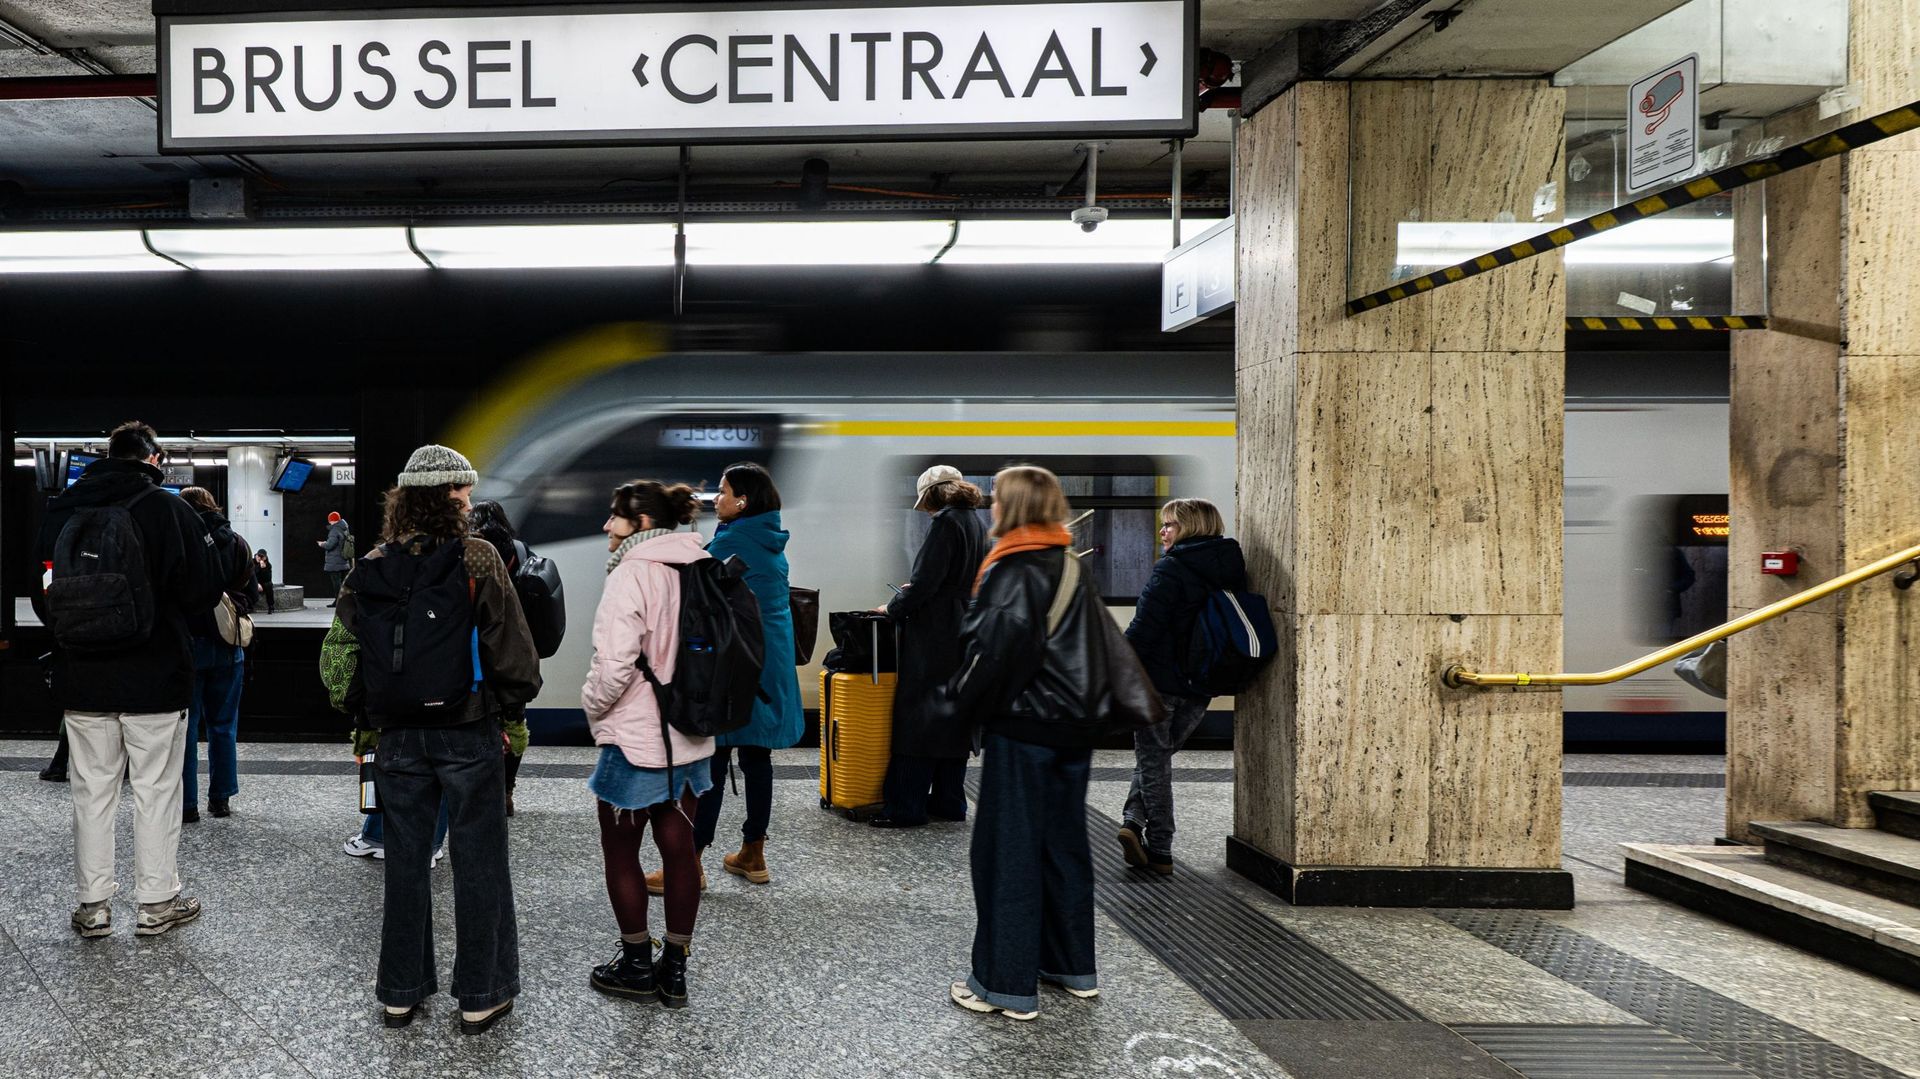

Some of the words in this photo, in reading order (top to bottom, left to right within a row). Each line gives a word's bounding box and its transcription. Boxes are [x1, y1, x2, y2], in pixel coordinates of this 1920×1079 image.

[193, 40, 557, 114] BRUSSEL
[661, 27, 1128, 104] CENTRAAL
[1176, 280, 1185, 308] F
